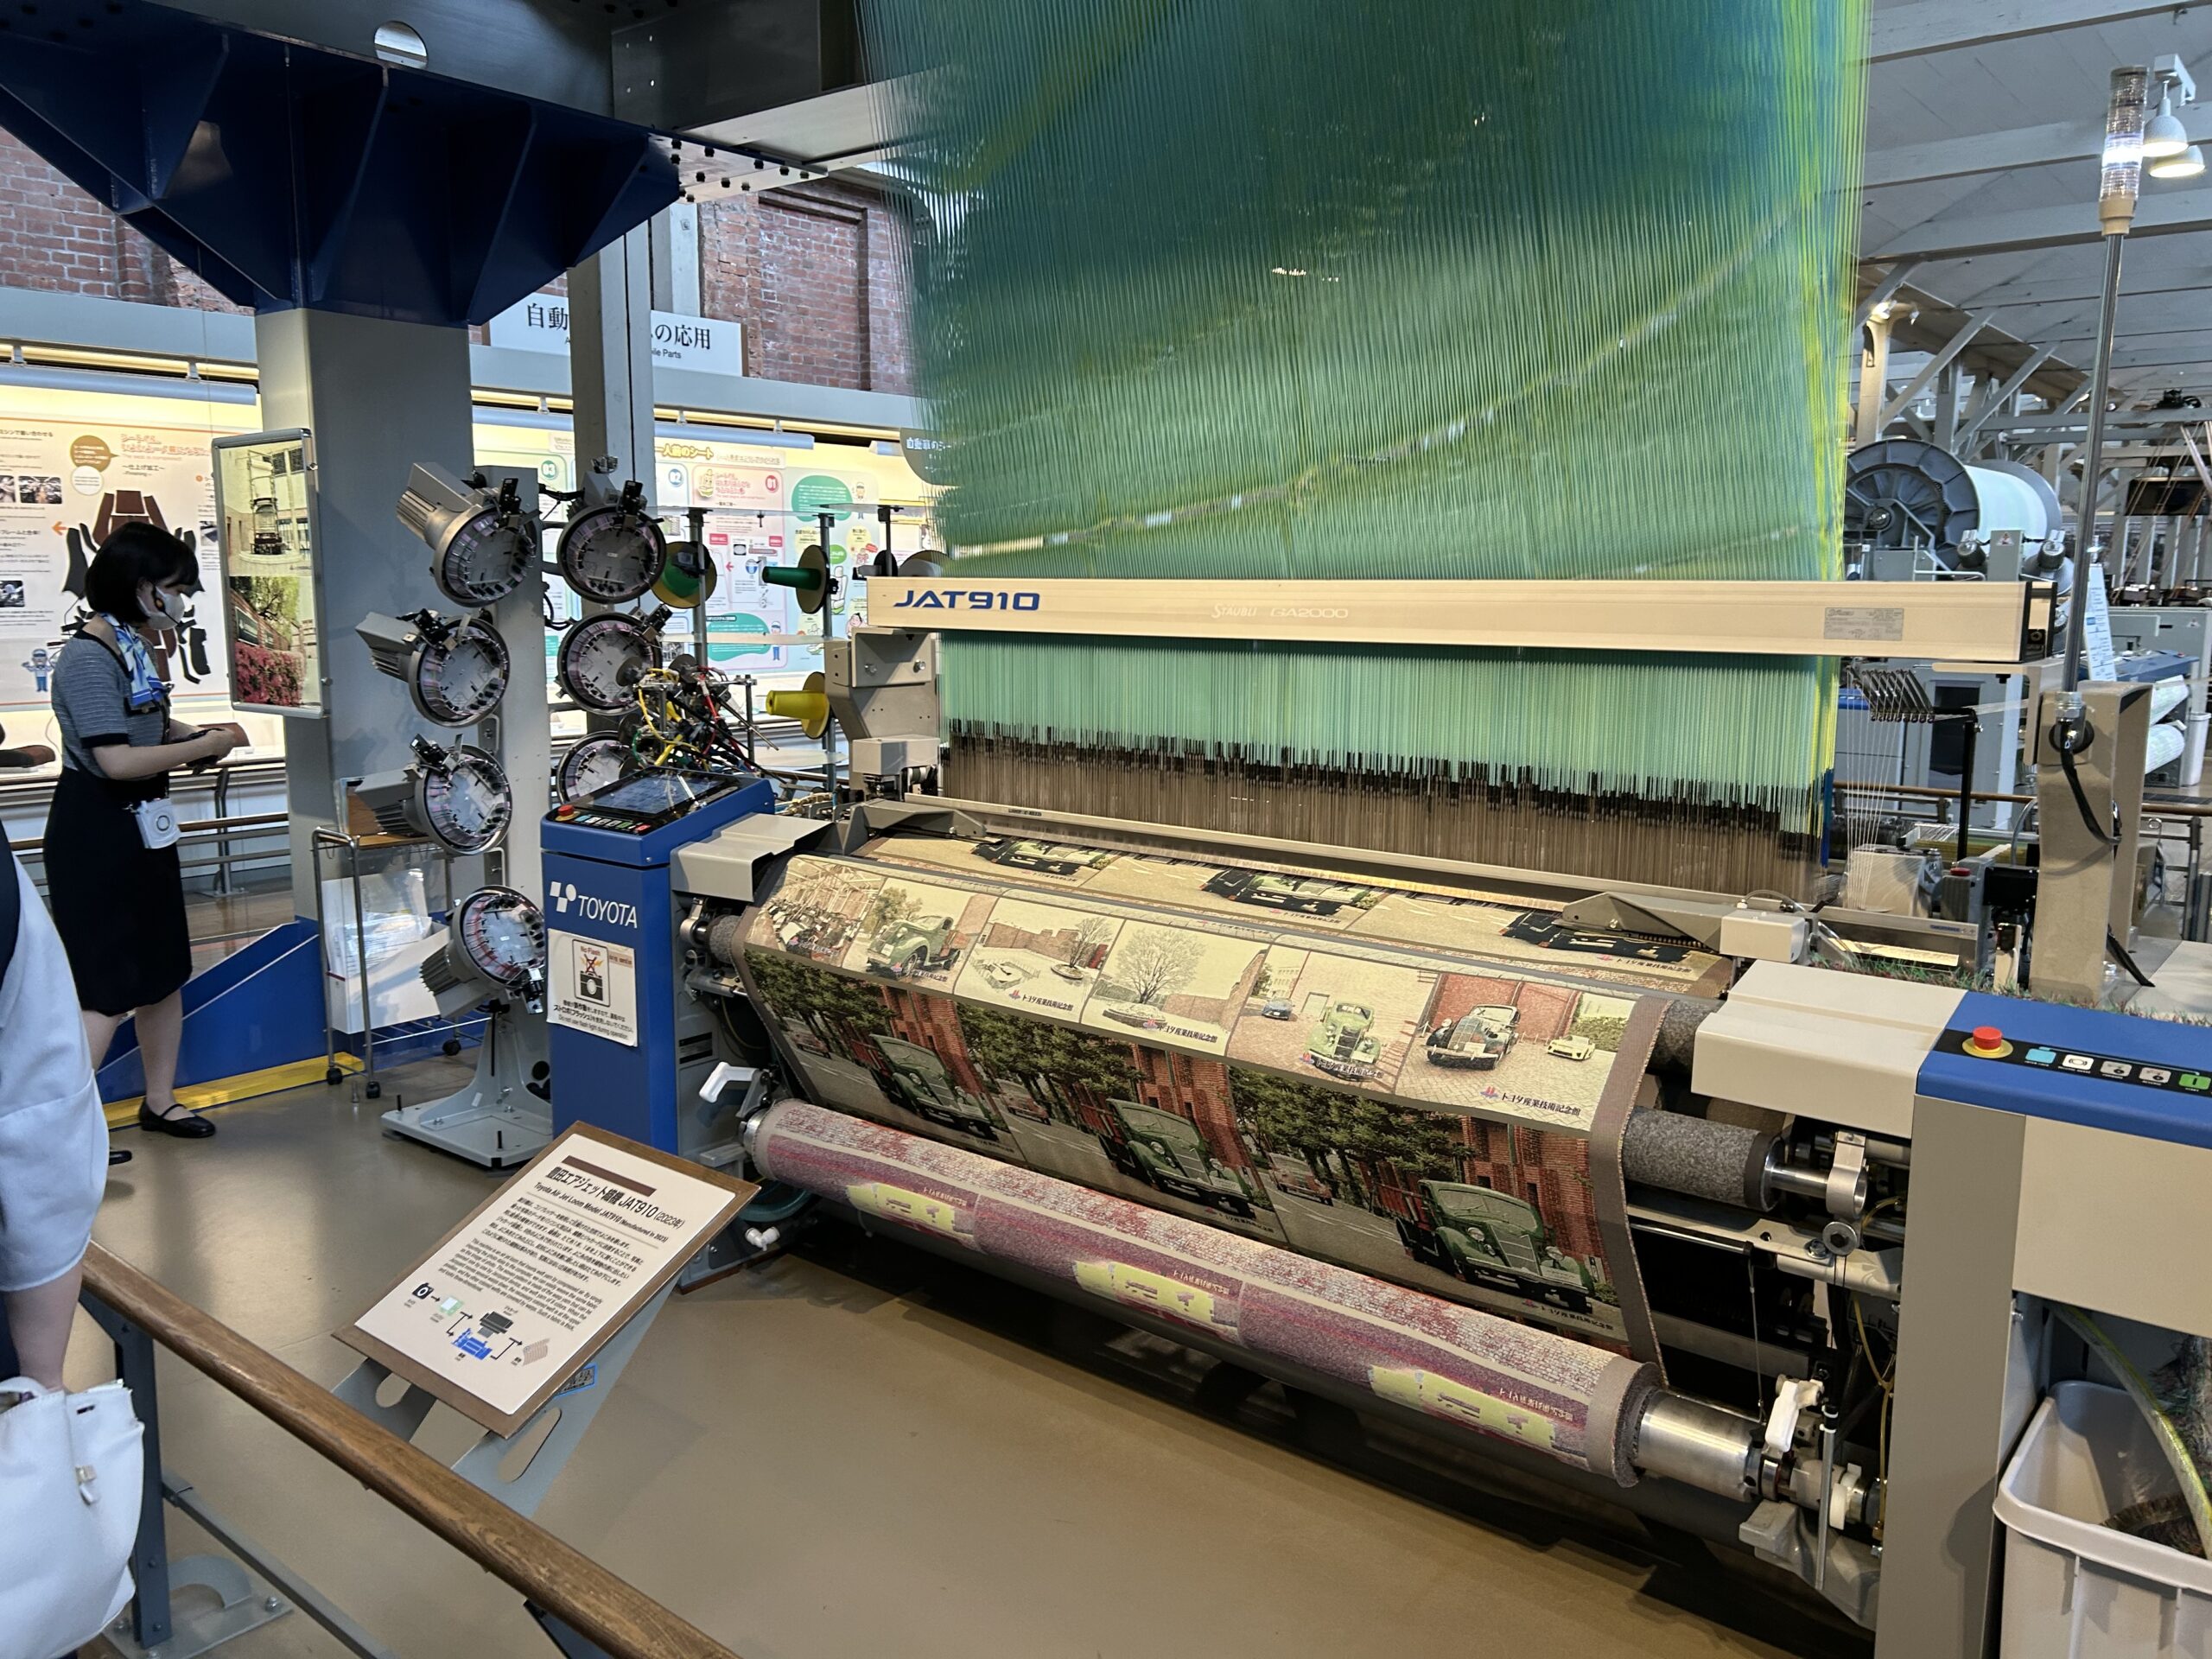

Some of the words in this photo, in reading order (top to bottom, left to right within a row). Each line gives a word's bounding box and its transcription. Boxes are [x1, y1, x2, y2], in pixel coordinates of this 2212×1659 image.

[663, 349, 682, 359] Parts
[893, 589, 1041, 613] JAT910
[578, 895, 638, 930] TOYOTA
[1501, 1092, 1581, 1116] トヨタ産業技術記念館
[531, 1182, 554, 1194] Toyota
[557, 1192, 571, 1201] Jet
[566, 1196, 586, 1207] Loom
[582, 1203, 602, 1214] Model
[598, 1210, 622, 1223] JAT910
[615, 1194, 660, 1219] JAT910
[652, 1210, 687, 1230] (2023年)
